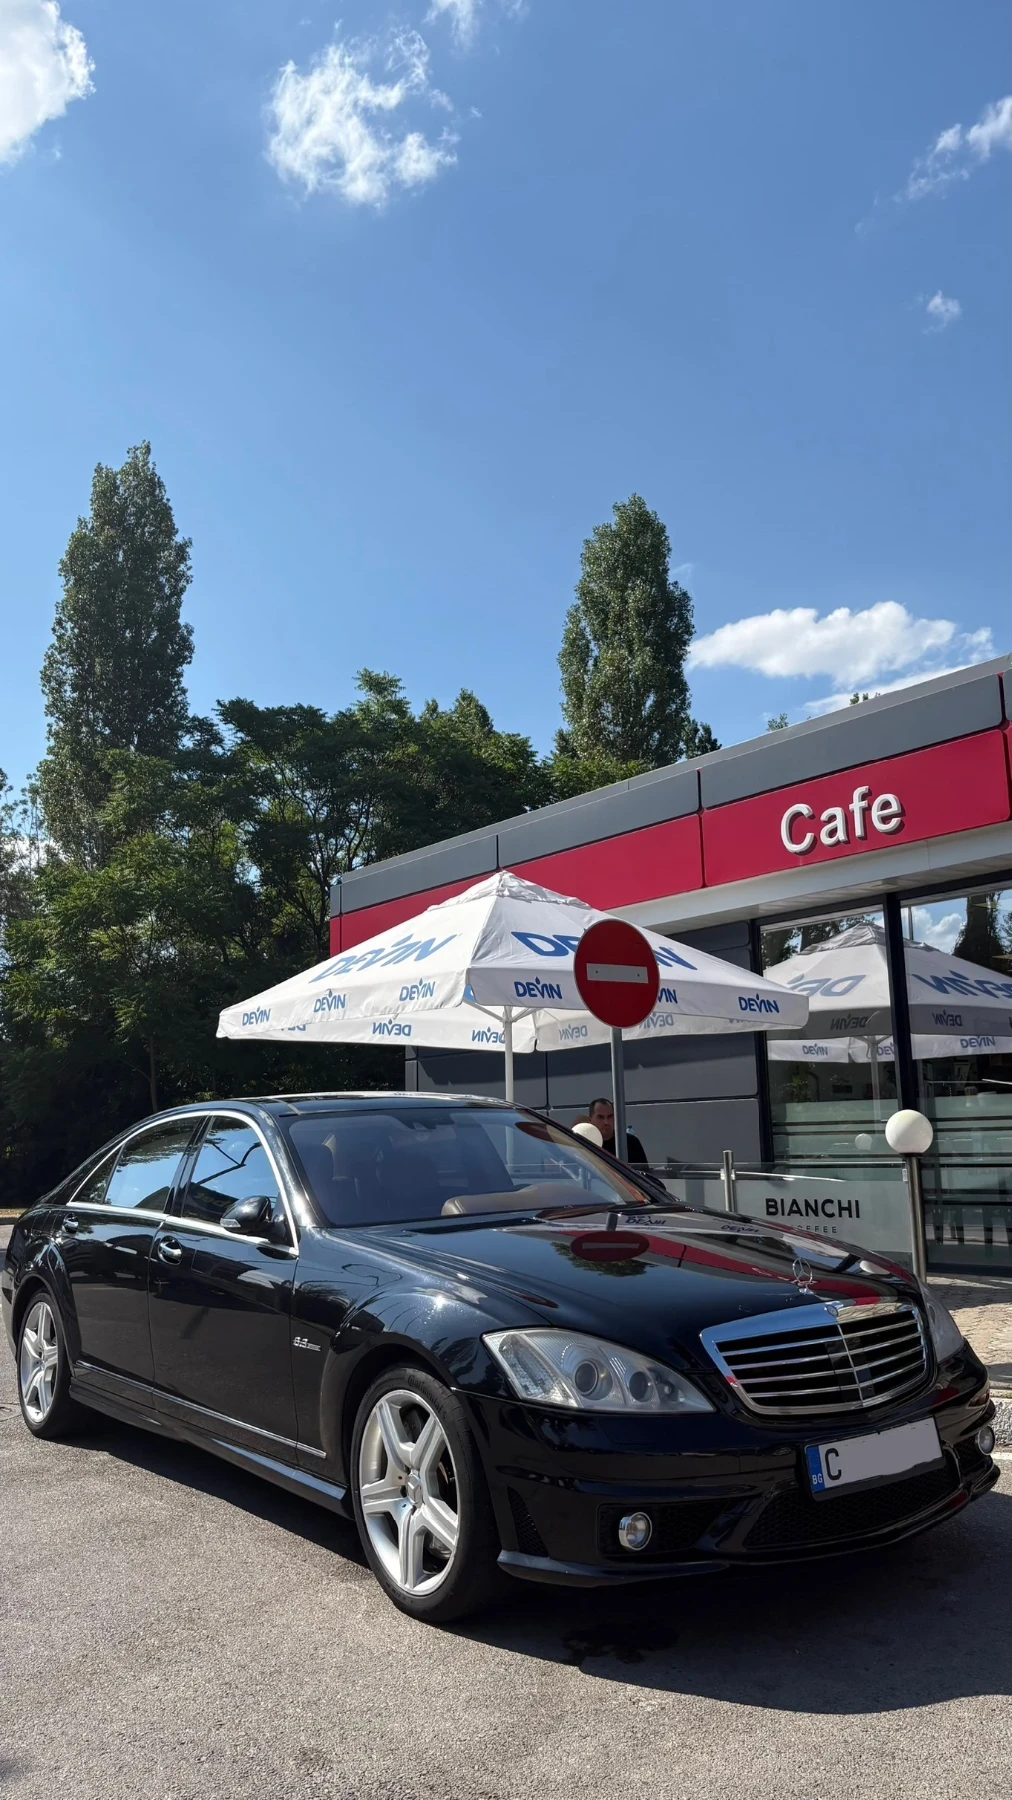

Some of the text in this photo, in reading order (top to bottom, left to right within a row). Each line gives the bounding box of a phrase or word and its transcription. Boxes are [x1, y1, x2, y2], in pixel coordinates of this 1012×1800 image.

[780, 786, 903, 853] Cafe
[308, 933, 458, 983] DEVIN
[400, 978, 435, 1001] DEVIN
[514, 977, 563, 1000] DEVIN
[313, 989, 346, 1013] DEVIN
[738, 993, 780, 1014] DEVIN
[242, 1006, 271, 1026] DEVIN
[802, 1043, 829, 1056] DEVIN
[960, 1036, 996, 1049] DEVIN
[765, 1198, 860, 1218] BIANCHI
[825, 1448, 842, 1481] C
[811, 1473, 823, 1485] BG
